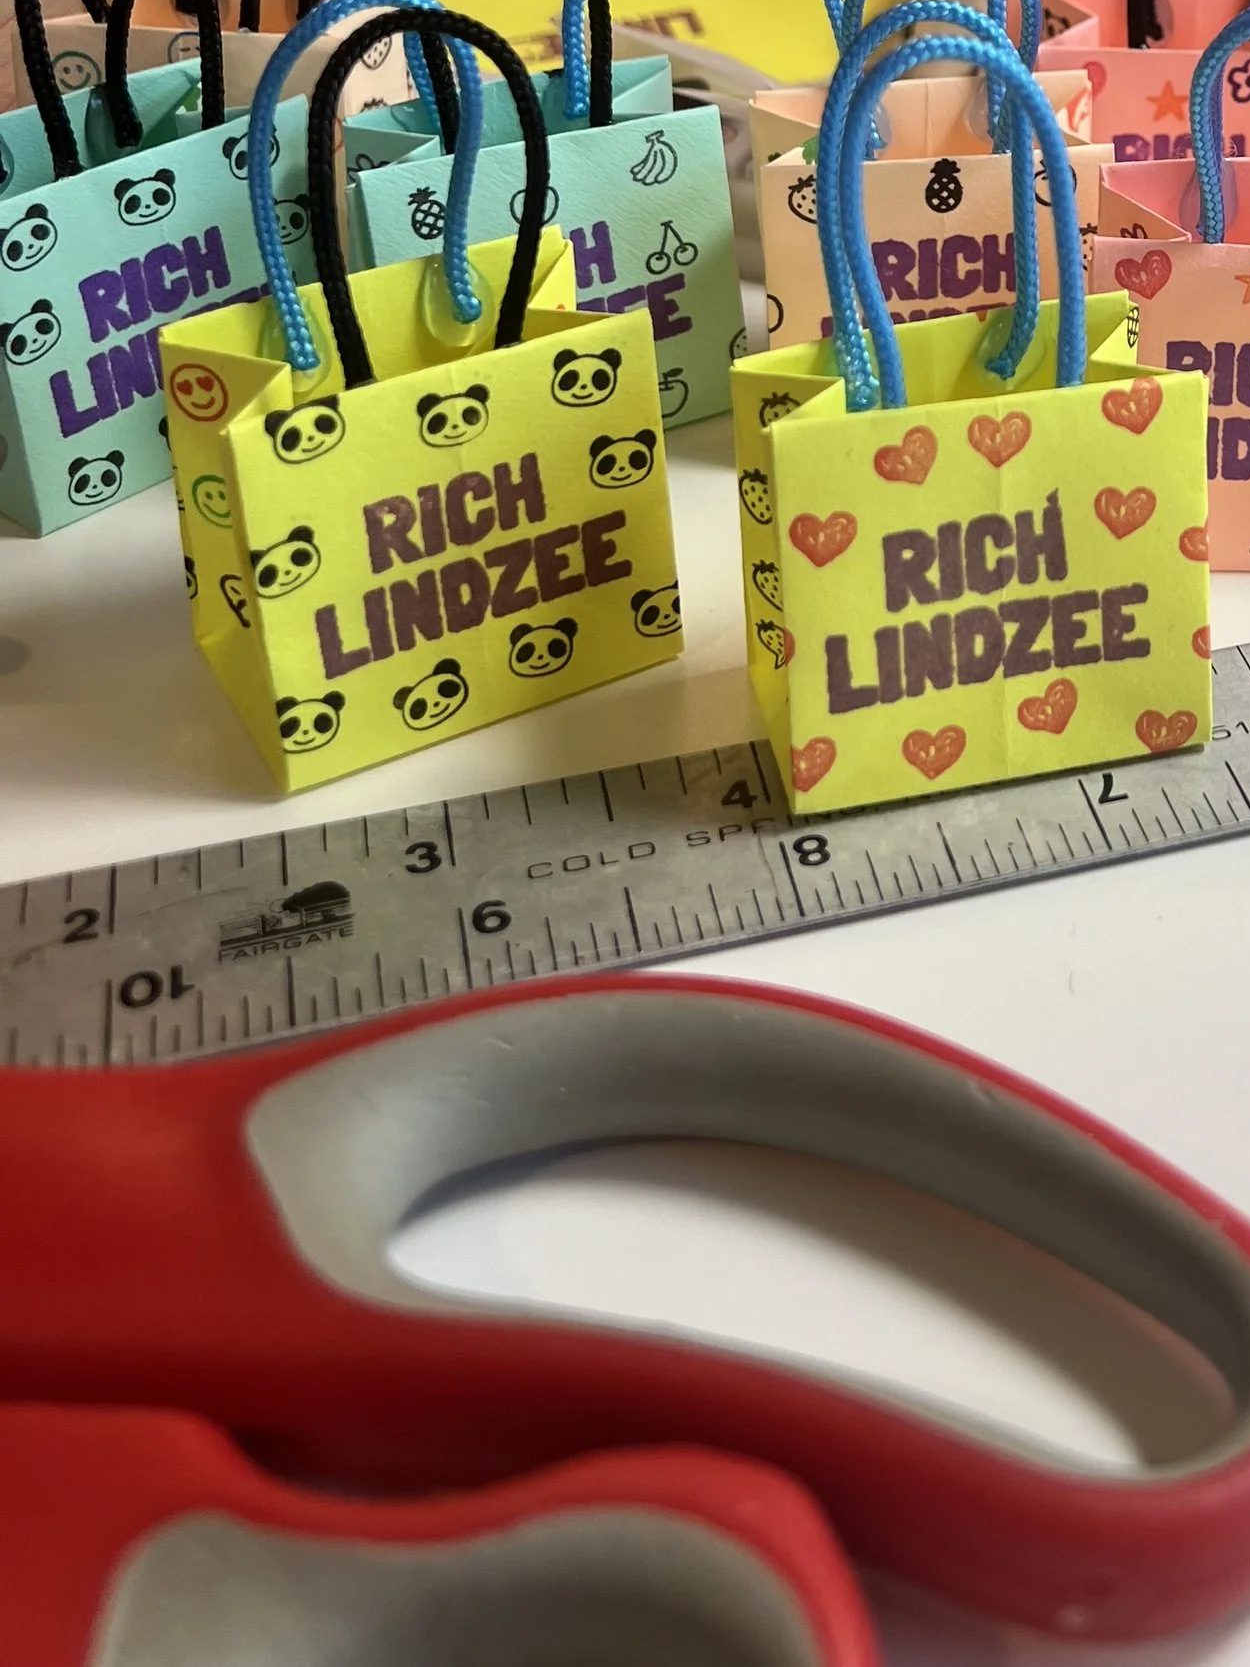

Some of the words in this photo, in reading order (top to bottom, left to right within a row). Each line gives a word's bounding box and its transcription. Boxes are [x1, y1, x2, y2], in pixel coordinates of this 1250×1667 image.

[78, 225, 231, 344] RICH
[871, 233, 1016, 301] RICH
[363, 452, 547, 574] RICH
[882, 488, 1068, 613] RICH
[315, 509, 632, 680] LINDZEE
[824, 582, 1151, 714] LINDZEE
[721, 779, 758, 808] 4
[1098, 772, 1129, 805] 7
[405, 841, 442, 874] 3
[527, 841, 656, 880] COLD
[792, 833, 831, 867] 8
[62, 908, 99, 943] 2
[218, 926, 354, 963] FAIRGATE
[119, 963, 195, 1009] 10
